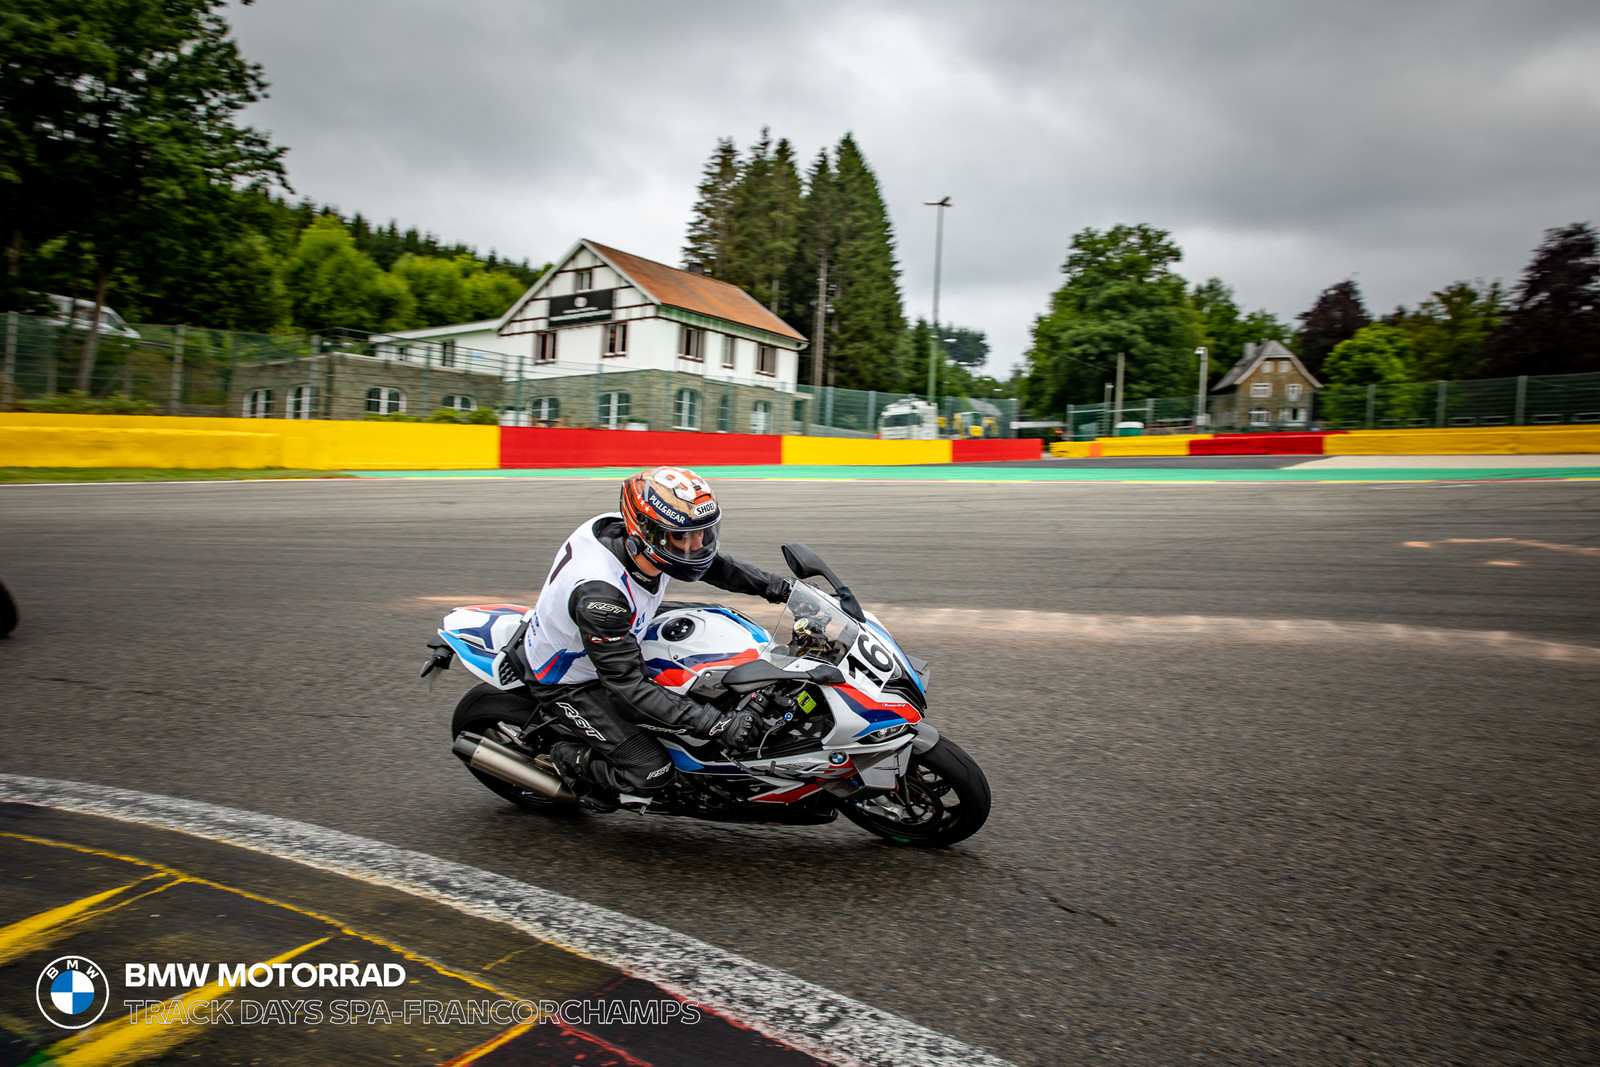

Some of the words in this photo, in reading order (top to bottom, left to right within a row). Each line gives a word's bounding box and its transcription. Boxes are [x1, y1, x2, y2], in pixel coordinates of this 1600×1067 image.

[649, 495, 686, 525] PULL&BEAR
[587, 601, 627, 614] RST
[846, 633, 894, 689] 16
[556, 701, 607, 742] RST
